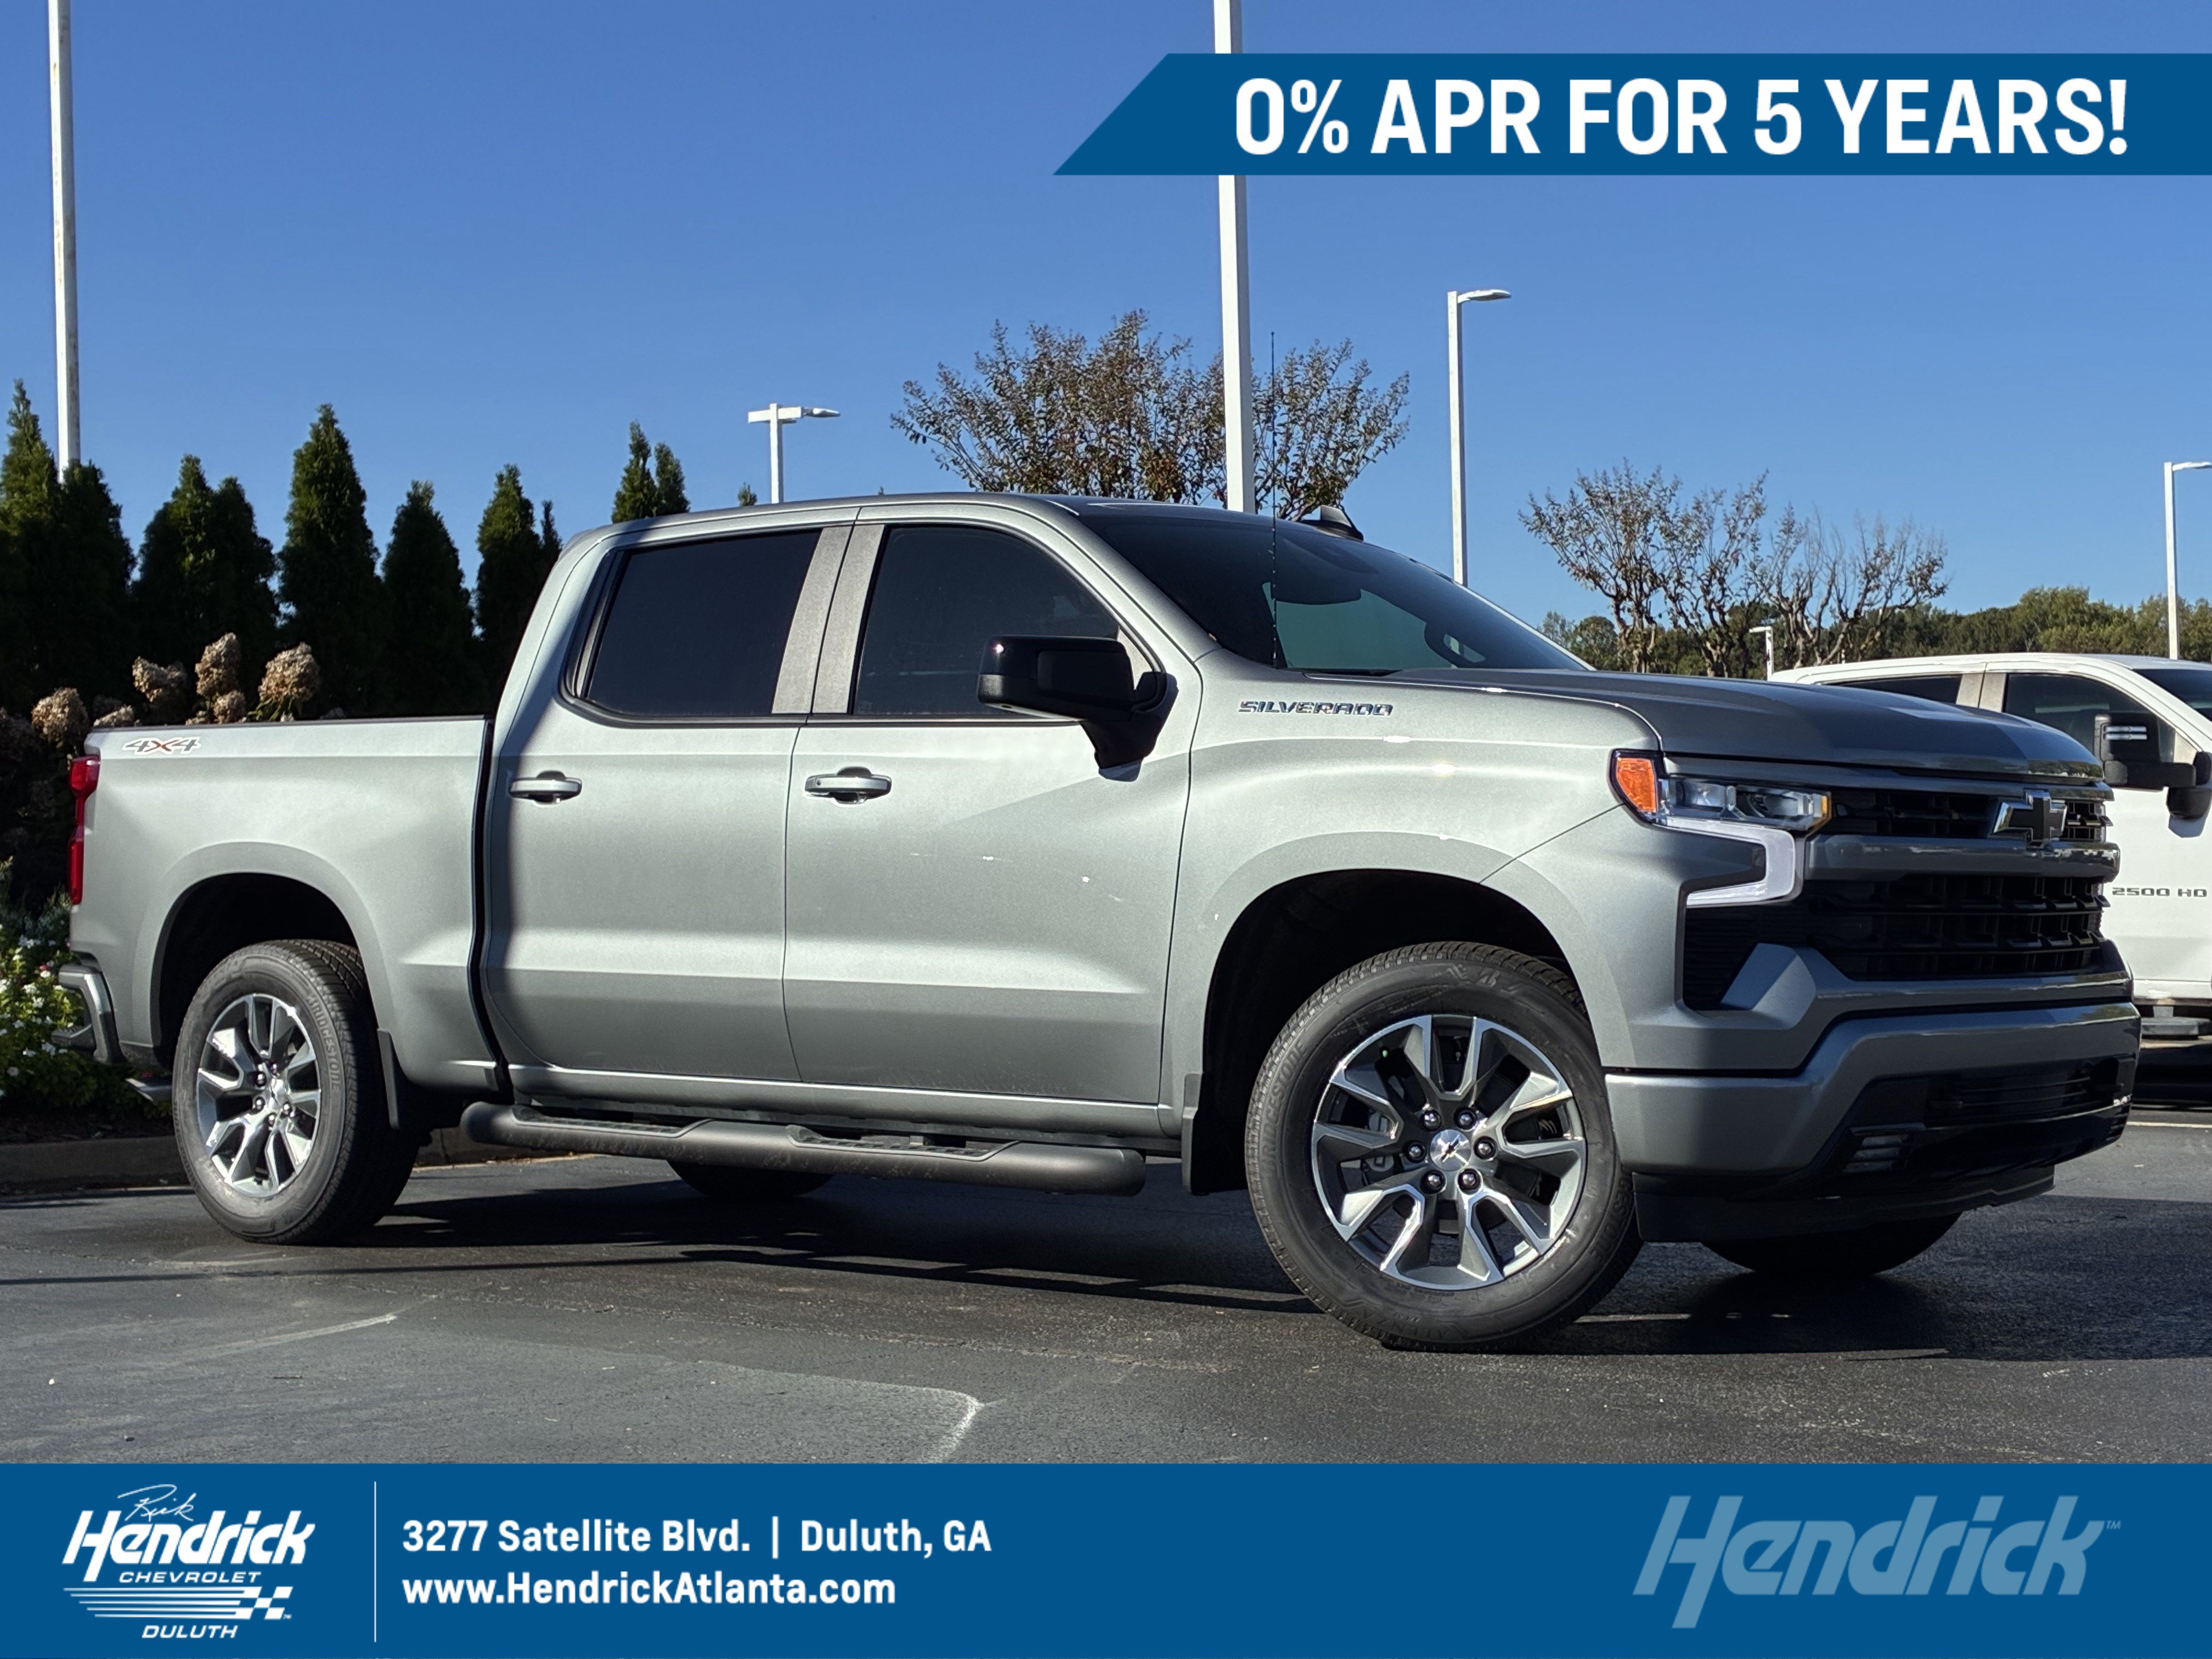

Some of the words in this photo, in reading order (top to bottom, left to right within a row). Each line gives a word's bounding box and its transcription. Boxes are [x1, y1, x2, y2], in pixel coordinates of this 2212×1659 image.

[1238, 701, 1393, 716] SILVERADO
[2112, 887, 2170, 896] 2500
[2177, 888, 2208, 898] HD
[306, 995, 341, 1091] BRIDGESTONE
[1261, 1040, 1308, 1173] BRIDGESTONE
